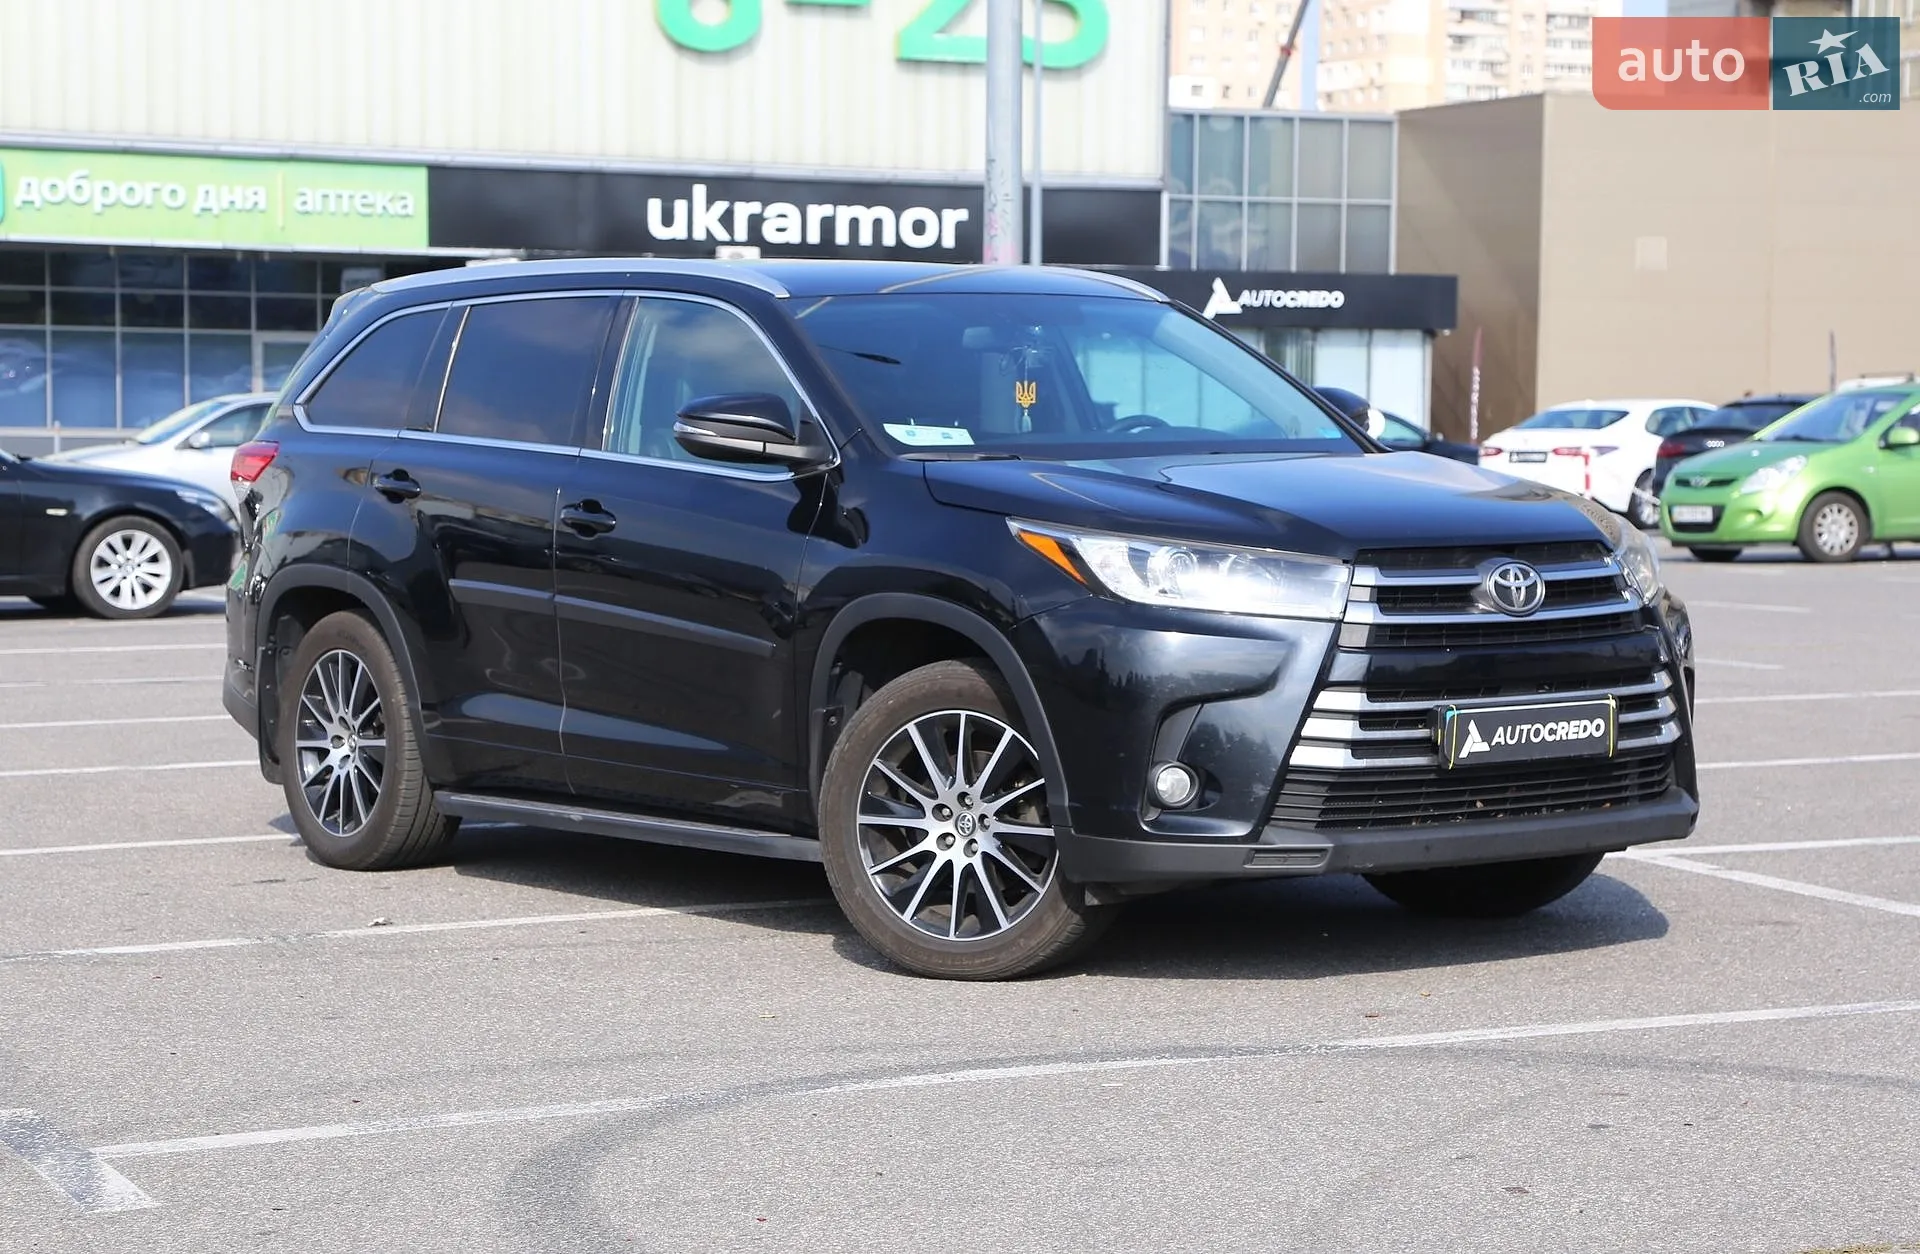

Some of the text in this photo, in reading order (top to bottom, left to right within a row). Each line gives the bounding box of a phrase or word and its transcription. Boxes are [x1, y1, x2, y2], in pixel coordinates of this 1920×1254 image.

[14, 169, 415, 216] доброго дня аптека
[646, 183, 969, 249] ukrarmor
[1238, 289, 1345, 308] AUTOCREDO
[1491, 717, 1605, 746] AUTOCREDO
